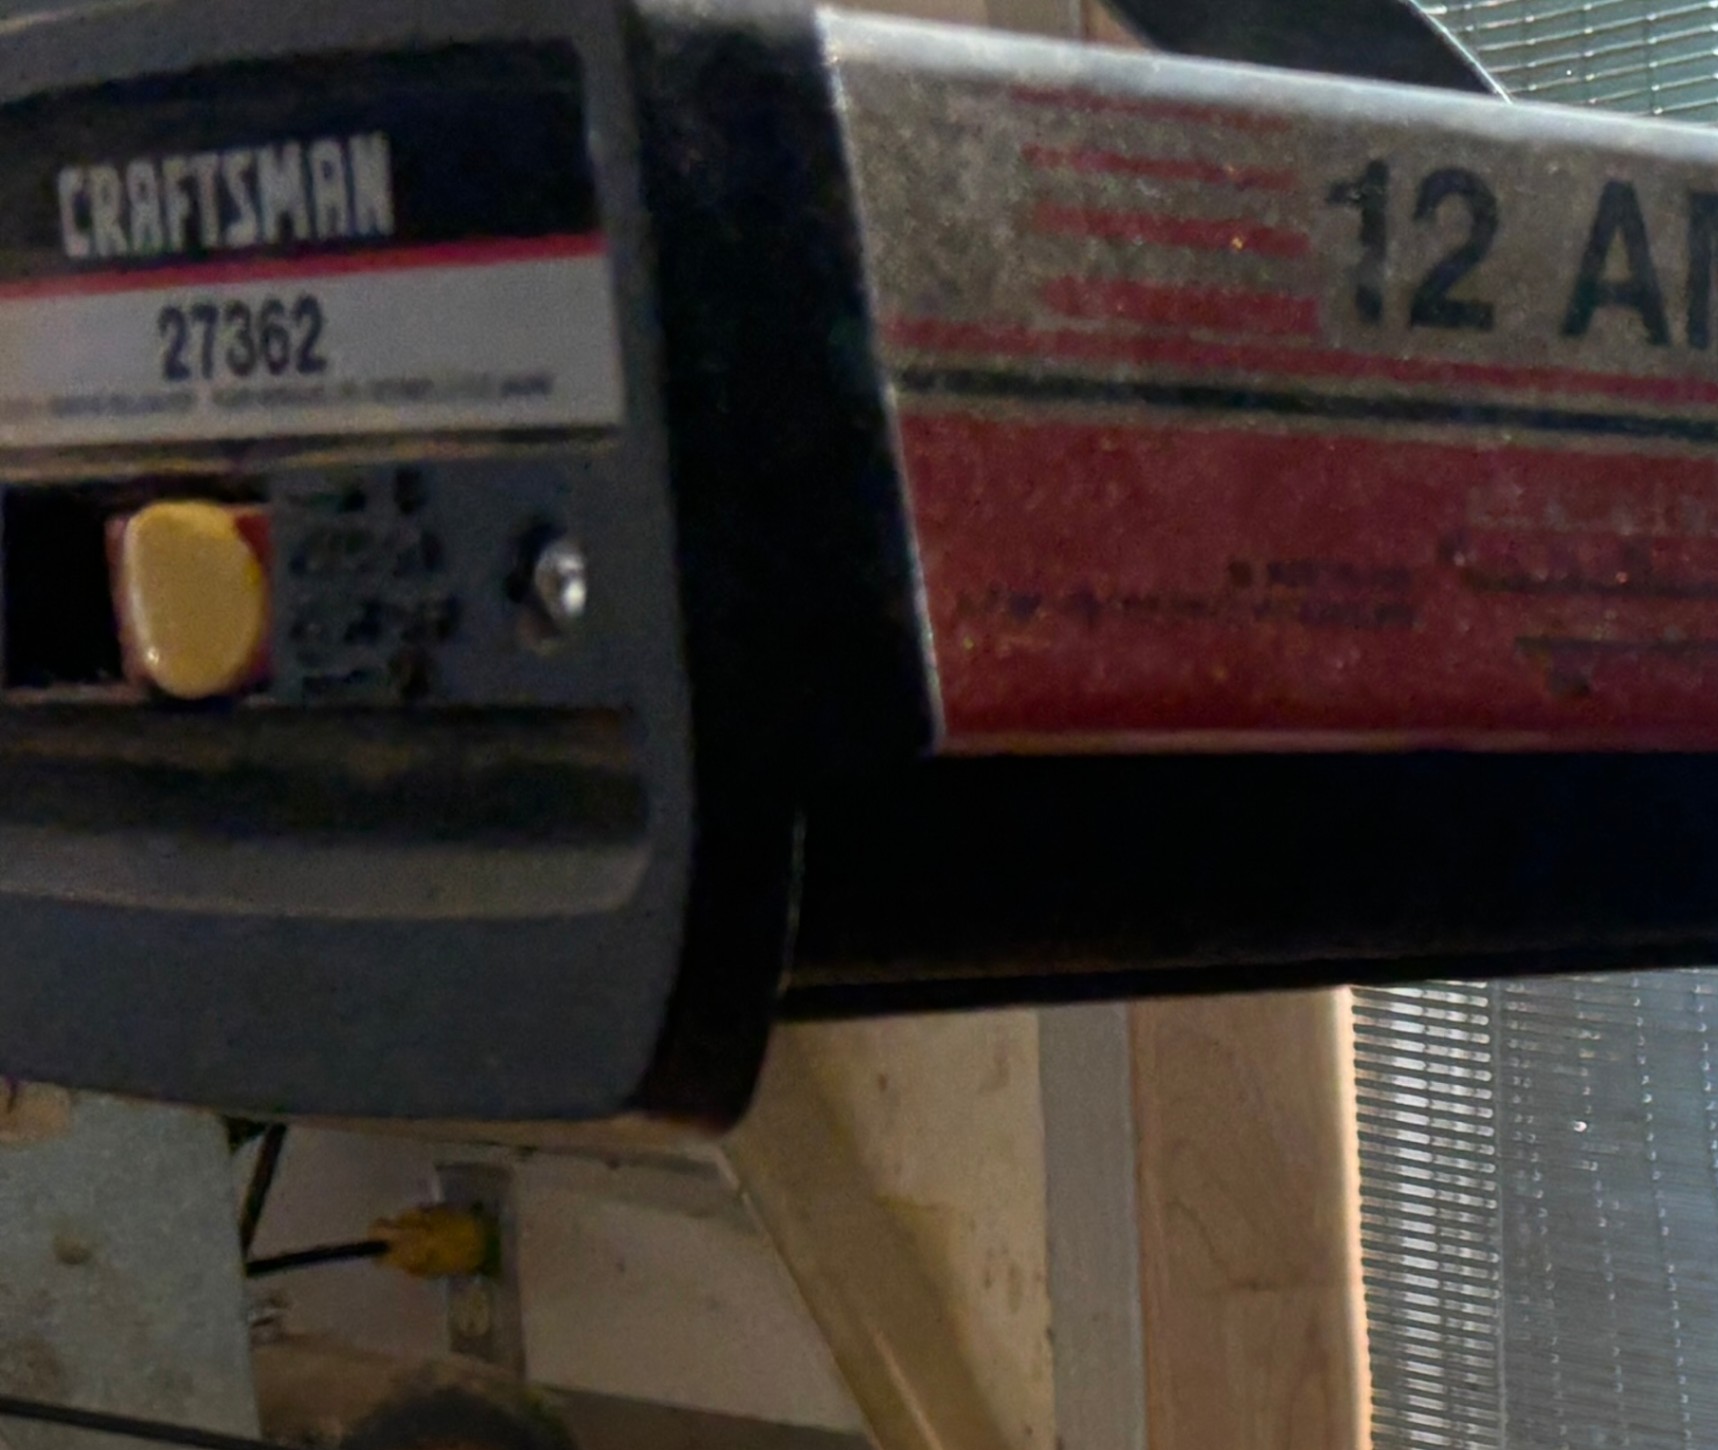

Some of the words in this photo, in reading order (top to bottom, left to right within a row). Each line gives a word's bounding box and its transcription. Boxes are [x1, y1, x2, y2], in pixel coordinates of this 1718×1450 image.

[57, 132, 394, 259] CRAFTSMAN
[1325, 159, 1498, 331] 12
[158, 296, 328, 382] 27362
